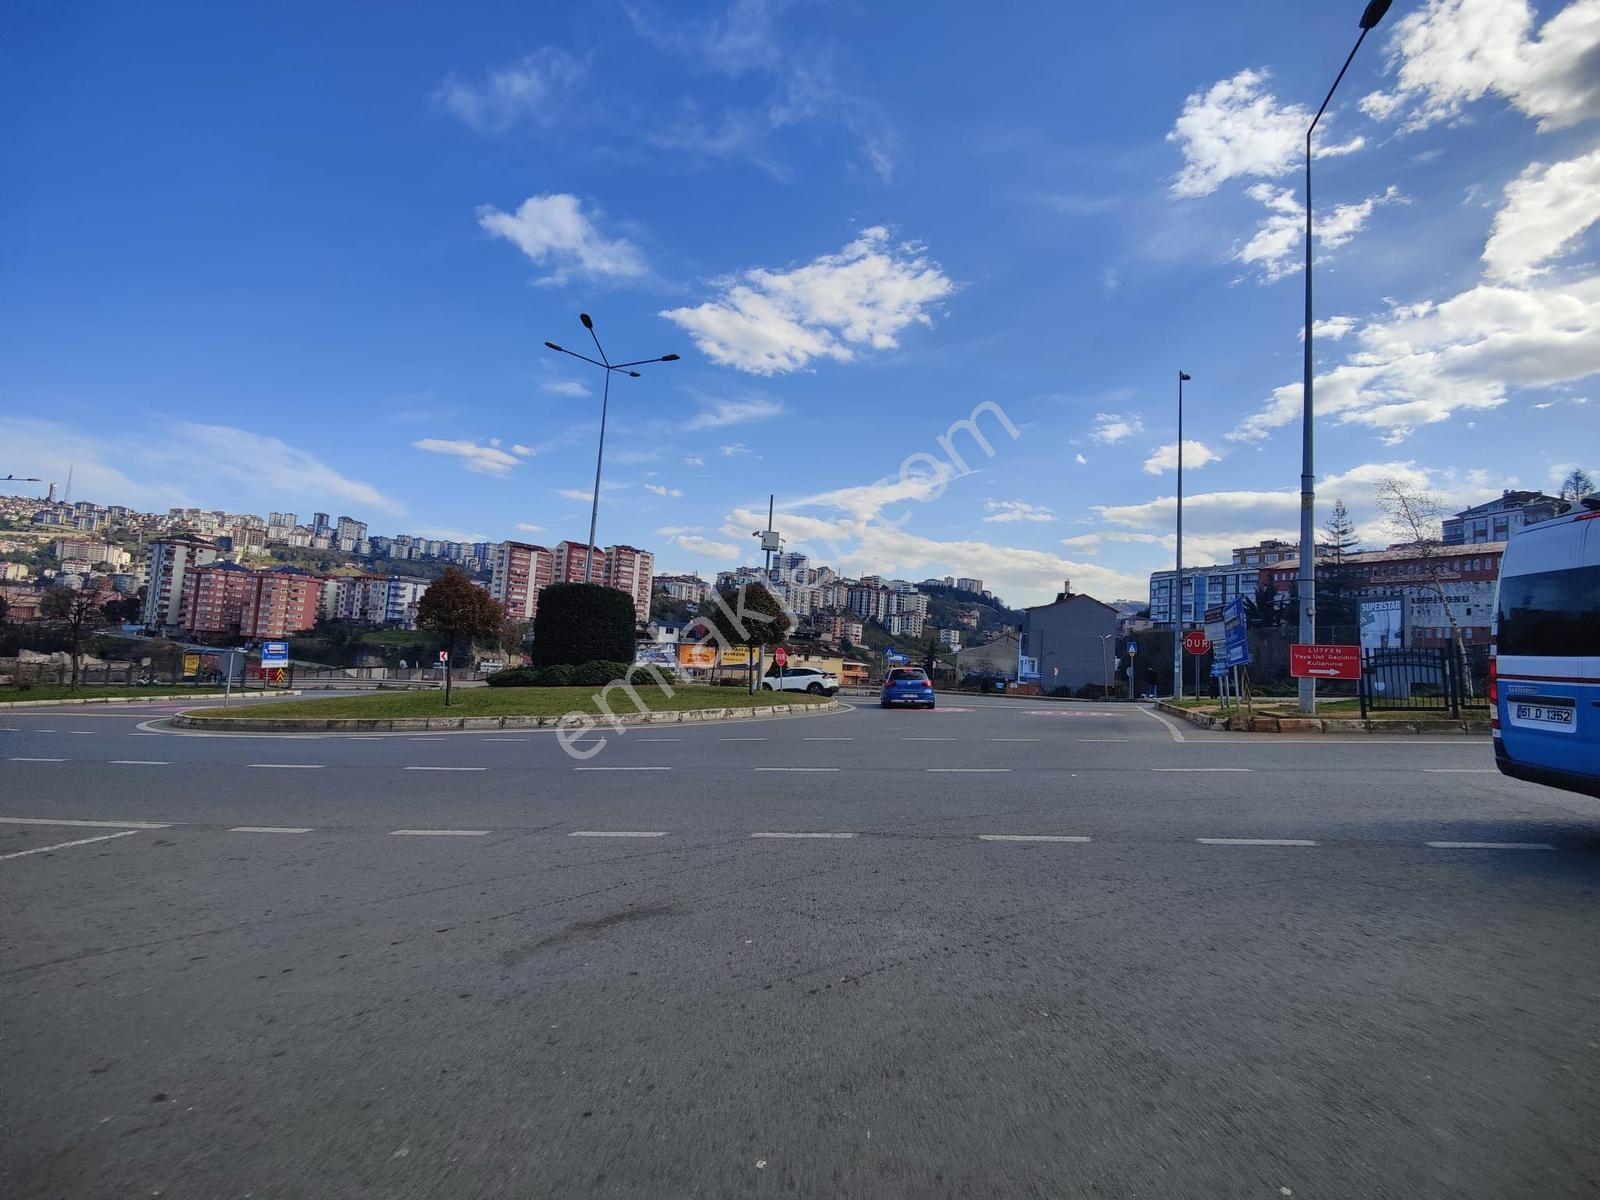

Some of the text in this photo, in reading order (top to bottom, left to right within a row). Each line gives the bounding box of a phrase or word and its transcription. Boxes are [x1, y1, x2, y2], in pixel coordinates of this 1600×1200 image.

[1361, 600, 1400, 612] SUPERSTAR
[1187, 639, 1208, 648] DUR
[1521, 707, 1570, 722] 61 D 1352
